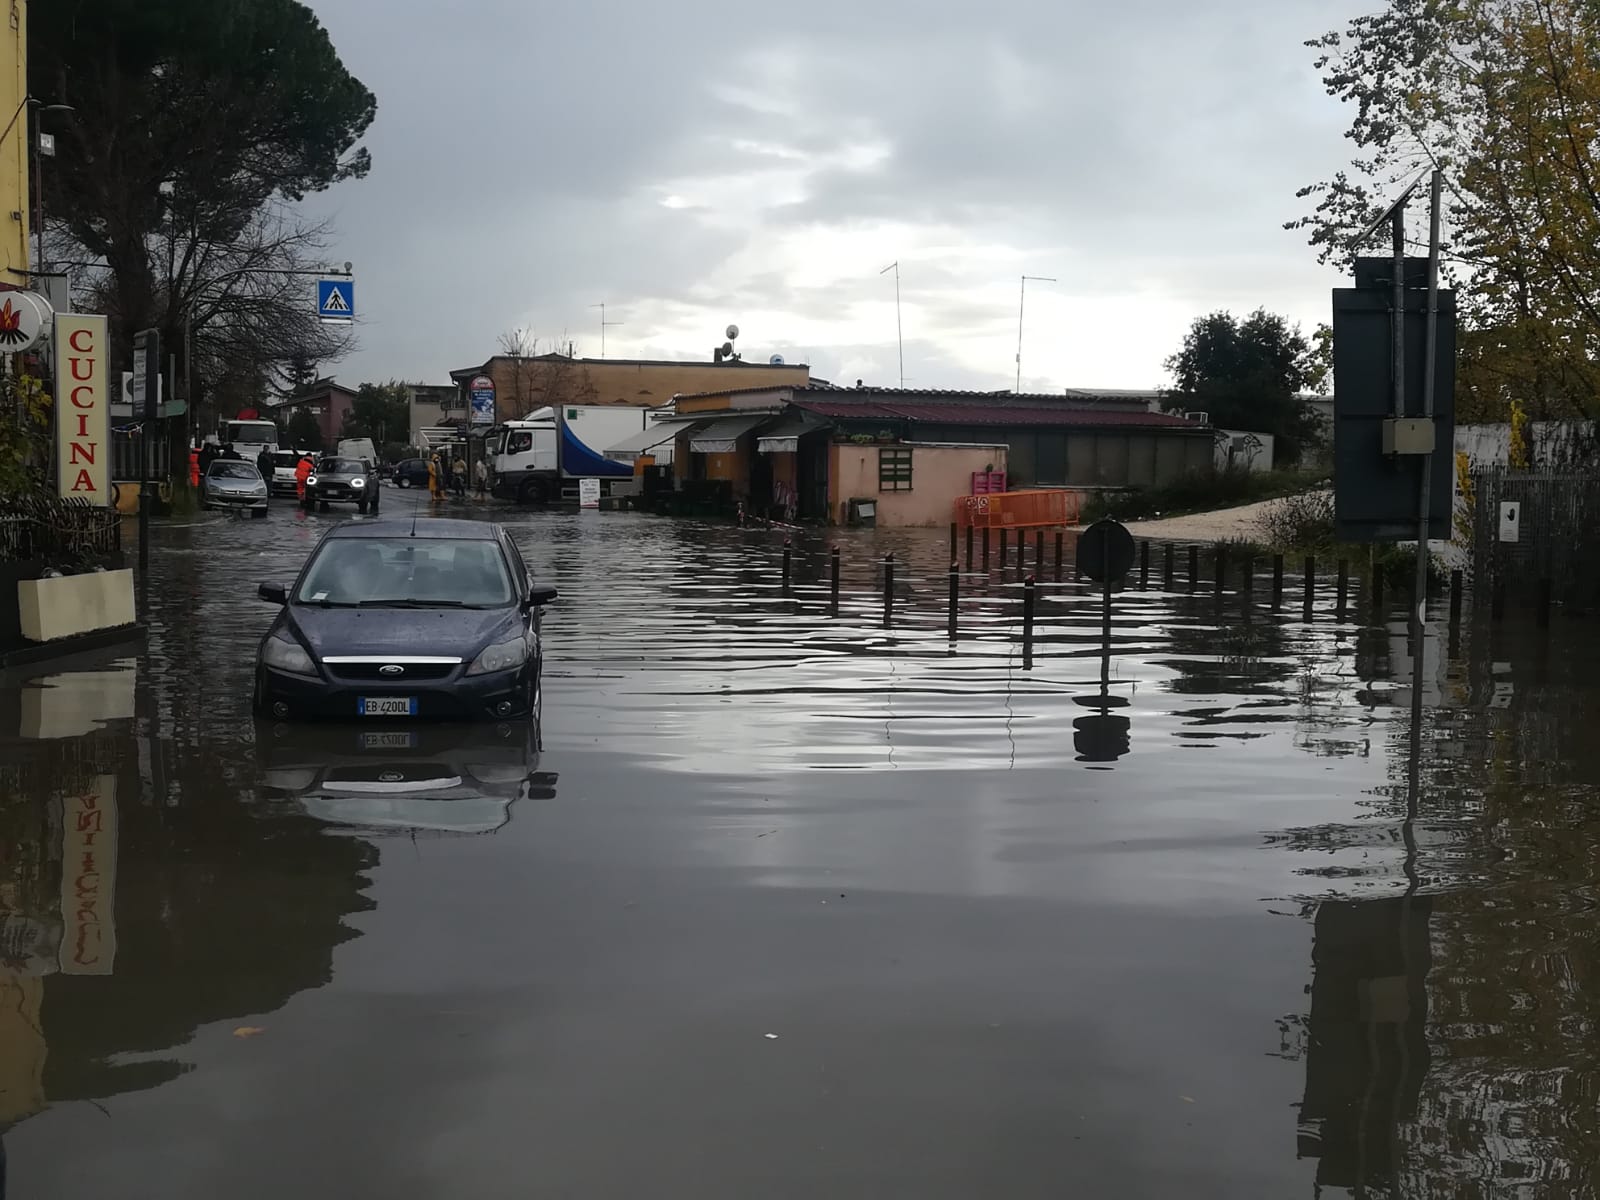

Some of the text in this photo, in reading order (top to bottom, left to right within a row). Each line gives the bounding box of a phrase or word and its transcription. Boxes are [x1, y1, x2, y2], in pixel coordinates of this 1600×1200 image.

[68, 329, 98, 492] CUCINA
[366, 701, 409, 712] EB 420DL
